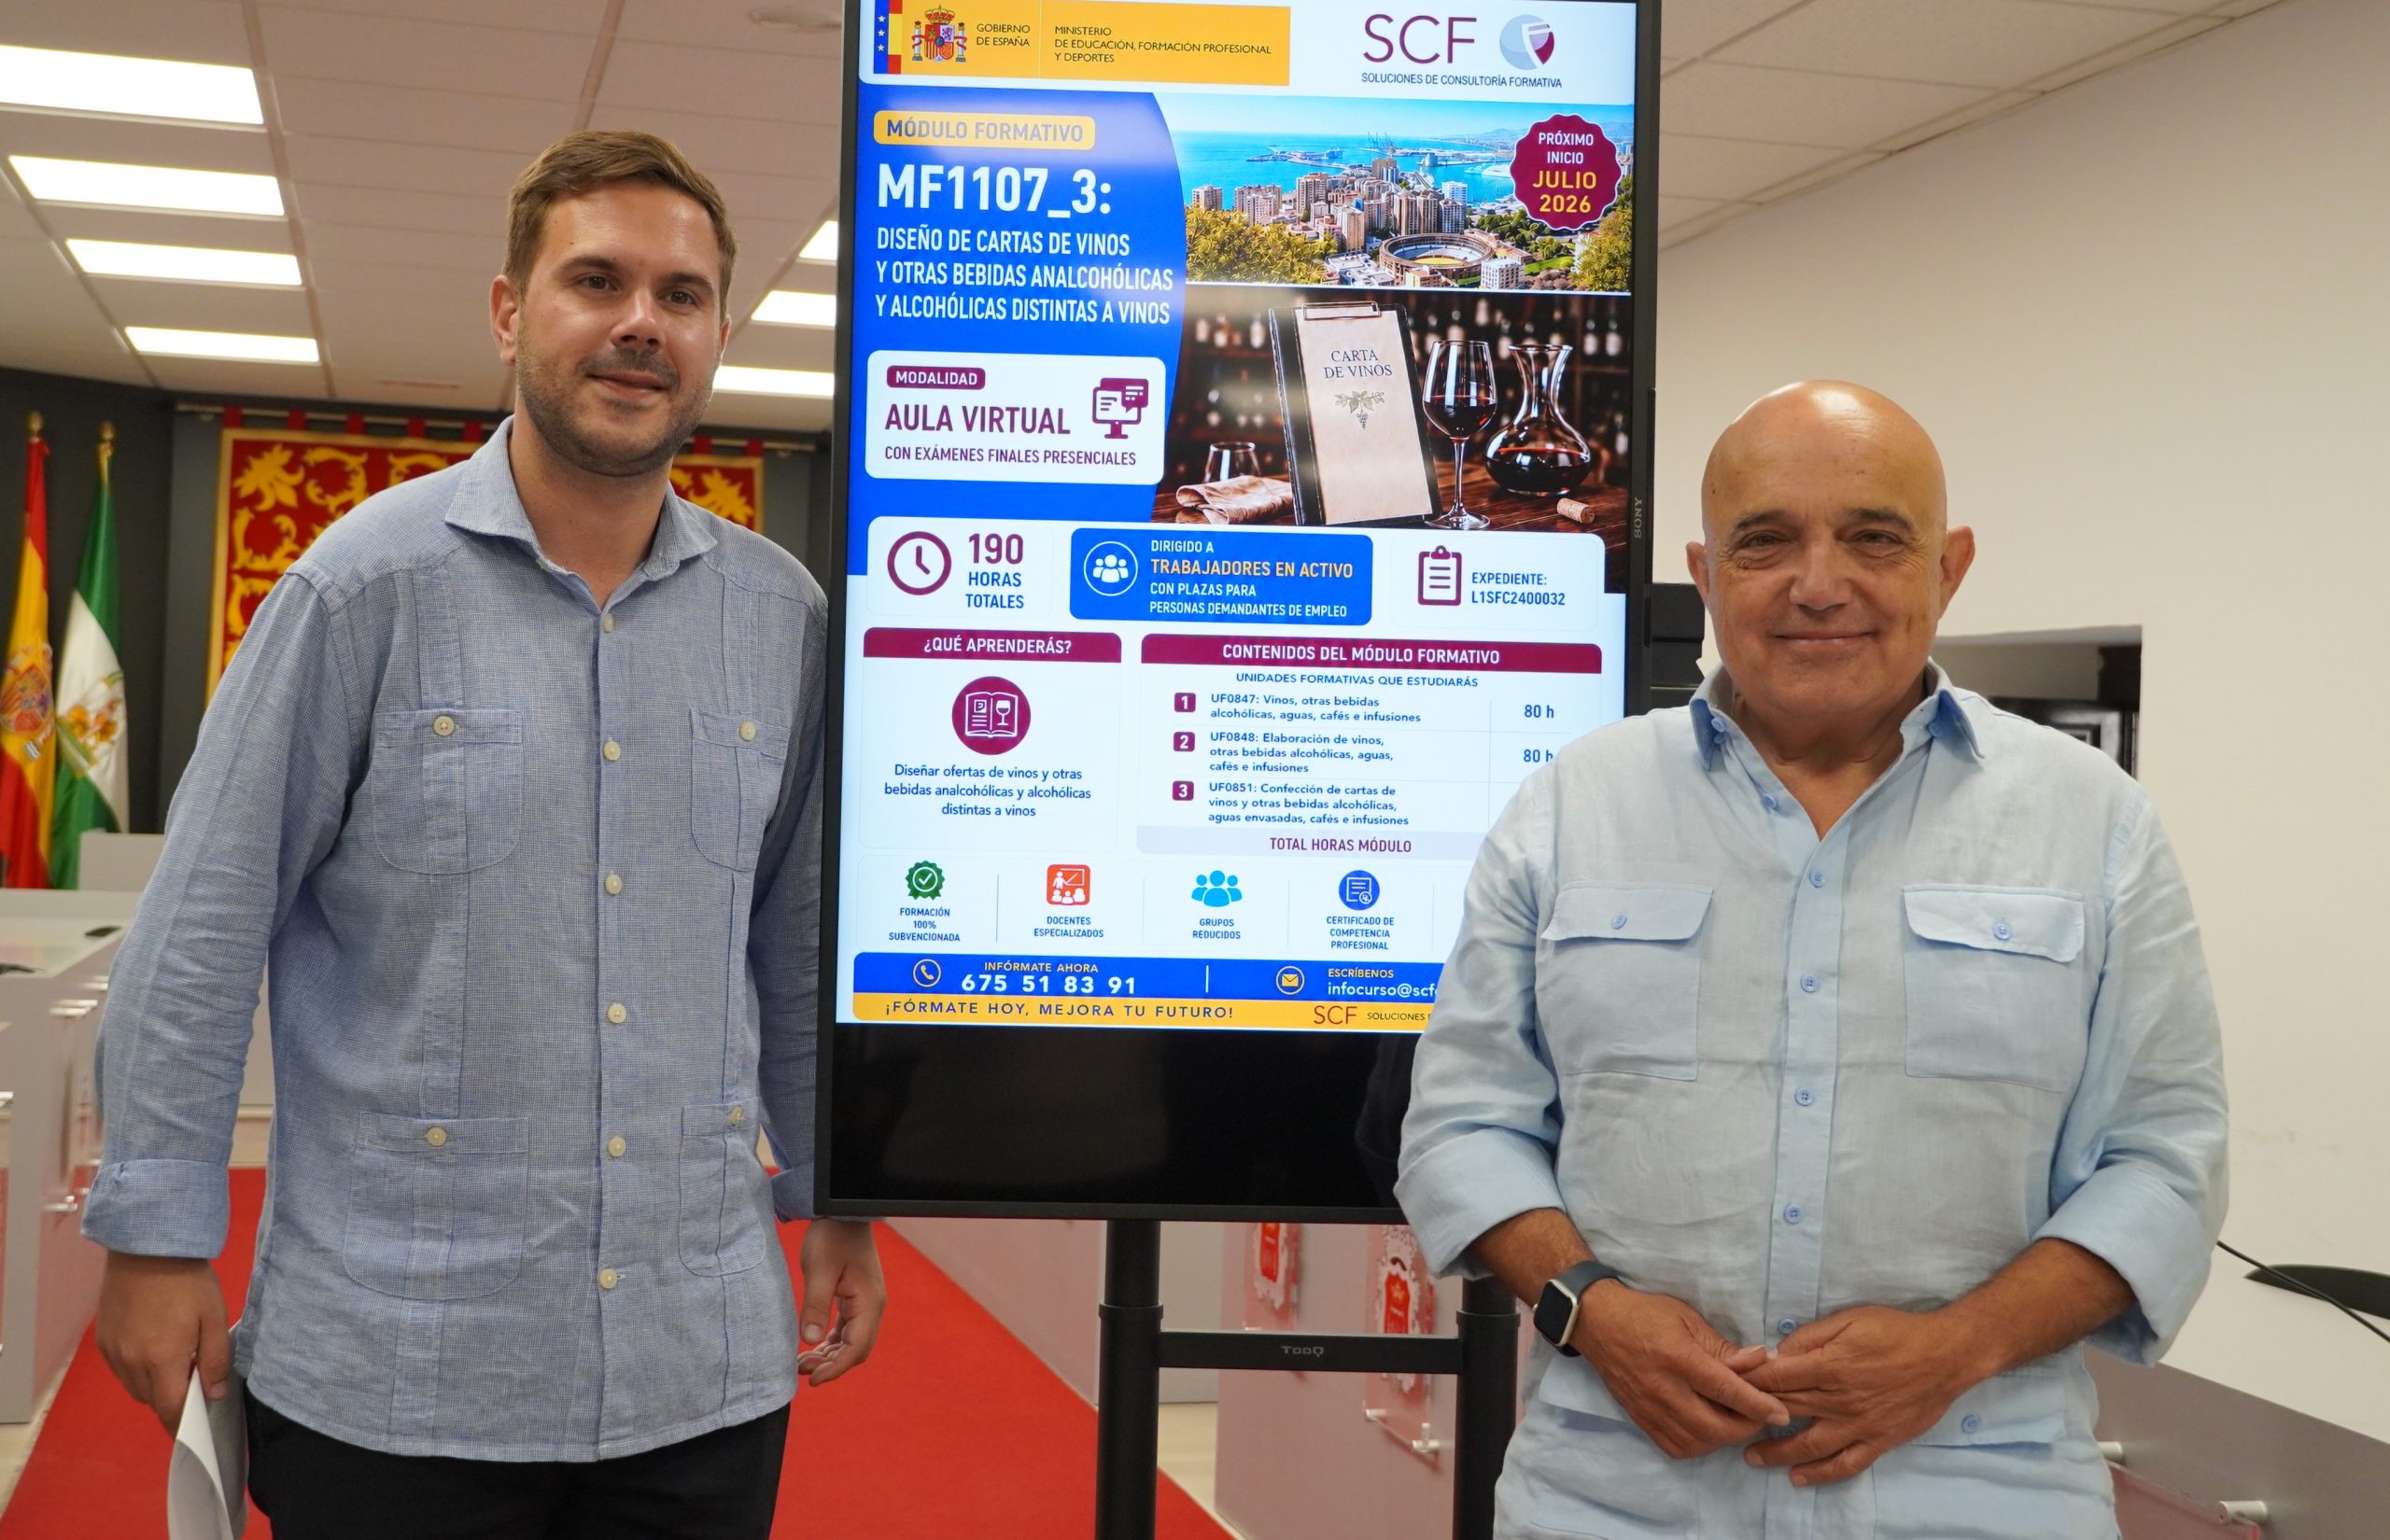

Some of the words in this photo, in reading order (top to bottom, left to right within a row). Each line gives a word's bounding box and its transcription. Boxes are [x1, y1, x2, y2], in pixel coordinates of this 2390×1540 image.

[977, 23, 1031, 35] GOBIERNO
[1055, 25, 1111, 36] MINISTERIO
[977, 36, 991, 47] DE
[993, 35, 1030, 47] ESPAÑA
[1055, 39, 1068, 49] DE
[1071, 38, 1135, 52] EDUCACIÓN,
[1138, 40, 1200, 52] FORMACIÓN
[1204, 43, 1271, 54] PROFESIONAL
[1363, 14, 1477, 63] SCF
[1055, 53, 1061, 62] Y
[1063, 53, 1115, 63] DEPORTES
[1362, 73, 1423, 84] SOLUCIONES
[1426, 75, 1439, 84] DE
[1441, 74, 1507, 87] CONSULTORÍA
[1510, 77, 1562, 88] FORMATIVA
[887, 117, 967, 139] MÓDULO
[975, 121, 1083, 142] FORMATIVO
[1539, 130, 1594, 146] PRÓXIMO
[1547, 152, 1583, 164] INICIO
[1532, 170, 1597, 189] JULIO
[879, 163, 1112, 218] MF1107_3:
[1539, 194, 1591, 214] 2026
[877, 224, 942, 251] DISEÑO
[949, 230, 971, 252] DE
[976, 230, 1043, 254] CARTAS
[1048, 232, 1071, 254] DE
[1076, 233, 1130, 256] VINOS
[876, 260, 887, 283] Y
[892, 261, 948, 285] OTRAS
[952, 263, 1026, 287] BEBIDAS
[1031, 262, 1174, 291] ANALCOHÓLICAS
[875, 295, 887, 316] Y
[890, 292, 1006, 320] ALCOHÓLICAS
[1012, 298, 1098, 322] DISTINTAS
[1102, 301, 1115, 323] A
[1118, 301, 1170, 324] VINOS
[1330, 349, 1379, 362] CARTA
[895, 371, 977, 385] MODALIDAD
[1323, 365, 1343, 379] DE
[1346, 364, 1392, 378] VINOS
[885, 403, 953, 432] AULA
[962, 405, 1071, 434] VIRTUAL
[885, 446, 911, 460] CON
[915, 444, 984, 462] EXÁMENES
[989, 449, 1040, 463] FINALES
[1044, 450, 1136, 466] PRESENCIALES
[1634, 497, 1642, 538] SONY
[969, 533, 1023, 565] 190
[1151, 539, 1202, 553] DIRIGIDO
[1205, 541, 1214, 553] A
[1151, 559, 1271, 578] TRABAJADORES
[1275, 561, 1295, 578] EN
[1299, 562, 1353, 579] ACTIVO
[968, 571, 1021, 587] HORAS
[1471, 572, 1547, 585] EXPEDIENTE:
[1150, 582, 1174, 596] CON
[1178, 583, 1222, 596] PLAZAS
[1226, 584, 1257, 597] PARA
[965, 593, 1024, 609] TOTALES
[1471, 590, 1566, 606] L1SFC2400032
[1149, 602, 1204, 615] PERSONAS
[1207, 603, 1286, 616] DEMANDANTES
[1289, 605, 1301, 616] DE
[1305, 605, 1347, 617] EMPLEO
[924, 635, 962, 652] ¿QUÉ
[966, 637, 1072, 653] APRENDERÁS?
[1223, 644, 1315, 661] CONTENIDOS
[1319, 646, 1347, 661] DEL
[1352, 644, 1413, 663] MÓDULO
[1417, 648, 1499, 665] FORMATIVO
[1236, 673, 1297, 683] UNIDADES
[1300, 674, 1375, 685] FORMATIVAS
[1378, 676, 1403, 686] QUE
[1407, 675, 1478, 687] ESTUDIARÁS
[1181, 695, 1189, 710] 1
[1211, 693, 1259, 705] UF0847:
[1262, 694, 1299, 707] Vinos,
[1301, 697, 1329, 706] otras
[1333, 695, 1379, 707] bebidas
[1210, 707, 1276, 721] alcohólicas,
[1280, 712, 1317, 723] aguas,
[1320, 710, 1351, 721] cafés
[1364, 711, 1421, 722] infusiones
[1524, 704, 1541, 718] 80
[1547, 705, 1554, 718] h
[1179, 735, 1189, 749] 2
[1210, 732, 1258, 743] UF0848:
[1262, 733, 1331, 745] Elaboración
[1335, 735, 1349, 745] de
[1352, 735, 1384, 747] vinos,
[1209, 748, 1238, 757] otras
[1241, 747, 1286, 758] bebidas
[1290, 748, 1355, 761] alcohólicas,
[1357, 751, 1394, 763] aguas,
[1524, 749, 1540, 763] 80
[1546, 749, 1554, 763] h
[894, 763, 940, 777] Diseñar
[943, 764, 986, 777] ofertas
[989, 766, 1004, 777] de
[1007, 766, 1038, 778] vinos
[1042, 769, 1048, 780] y
[1052, 768, 1082, 779] otras
[1209, 761, 1239, 771] cafés
[1252, 762, 1309, 773] infusiones
[884, 782, 932, 795] bebidas
[935, 784, 1014, 797] analcohólicas
[1017, 788, 1024, 800] y
[1027, 786, 1091, 799] alcohólicas
[1178, 784, 1188, 798] 3
[1209, 782, 1258, 792] UF0851:
[1260, 783, 1324, 794] Confección
[1327, 785, 1342, 794] de
[1344, 786, 1379, 795] cartas
[1382, 785, 1396, 795] de
[941, 804, 991, 816] distintas
[994, 807, 1002, 816] a
[1005, 805, 1035, 817] vinos
[1209, 798, 1239, 807] vinos
[1242, 801, 1248, 810] y
[1252, 799, 1281, 809] otras
[1284, 798, 1329, 809] bebidas
[1332, 799, 1398, 813] alcohólicas,
[1208, 815, 1242, 825] aguas
[1244, 814, 1306, 826] envasadas,
[1310, 814, 1340, 825] cafés
[1352, 815, 1409, 826] infusiones
[1270, 837, 1307, 851] TOTAL
[1312, 838, 1354, 852] HORAS
[1358, 836, 1412, 853] MÓDULO
[900, 905, 949, 917] FORMACIÓN
[913, 920, 936, 929] 100%
[1047, 916, 1091, 925] DOCENTES
[1199, 918, 1234, 927] GRUPOS
[1327, 916, 1381, 926] CERTIFICADO
[1383, 917, 1394, 926] DE
[889, 932, 960, 942] SUBVENCIONADA
[1033, 928, 1104, 938] ESPECIALIZADOS
[1192, 931, 1241, 939] REDUCIDOS
[1329, 928, 1390, 938] COMPETENCIA
[1330, 941, 1388, 950] PROFESIONAL
[984, 959, 1051, 973] INFÓRMATE
[1057, 963, 1099, 973] AHORA
[1328, 966, 1394, 978] ESCRÍBENOS
[962, 974, 1007, 992] 675
[1022, 975, 1048, 992] 51
[1063, 976, 1094, 993] 83
[1108, 976, 1135, 994] 91
[887, 998, 978, 1015] ¡FÓRMATE
[988, 1002, 1029, 1016] HOY,
[1039, 1003, 1114, 1016] MEJORA
[1124, 1005, 1146, 1016] TU
[1156, 1006, 1233, 1018] FUTURO!
[1314, 1006, 1357, 1025] SCF
[1367, 1012, 1425, 1021] SOLUCIONES
